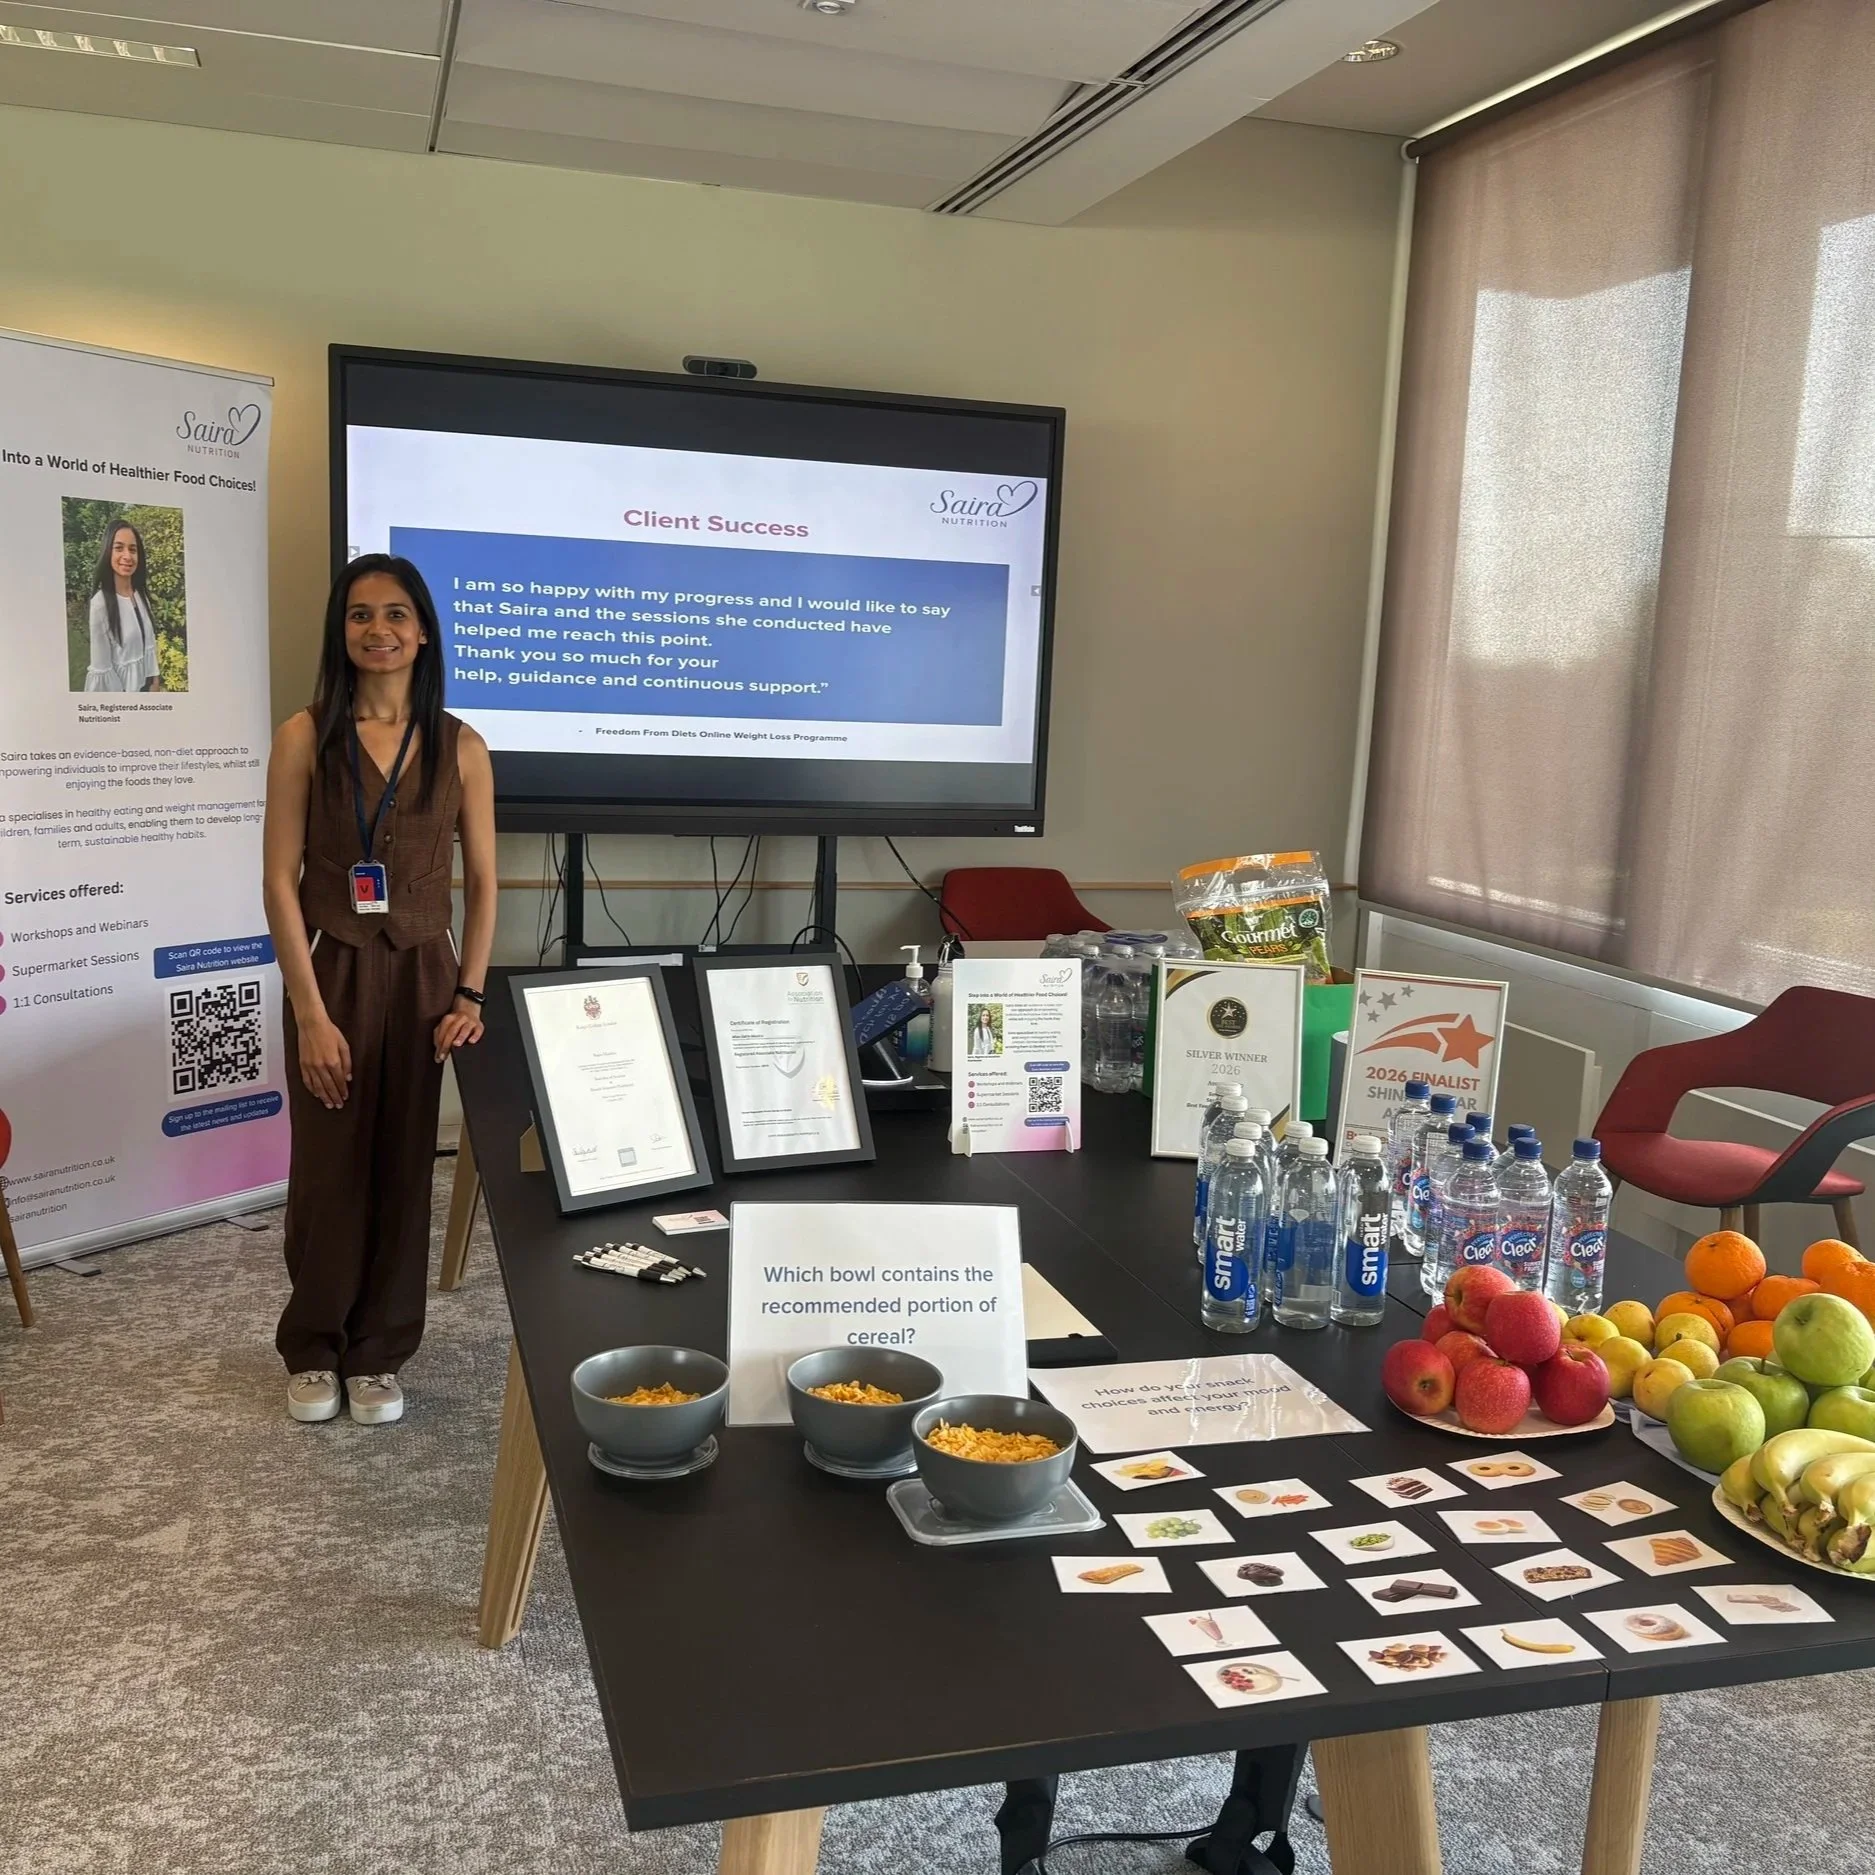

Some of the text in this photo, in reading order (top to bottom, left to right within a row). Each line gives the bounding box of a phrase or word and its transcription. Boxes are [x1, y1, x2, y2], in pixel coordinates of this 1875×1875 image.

[176, 409, 243, 446] Saira
[187, 444, 240, 459] NUTRITION
[2, 450, 256, 492] Into a World of Healthier Food Choices!
[930, 487, 1012, 518] Saira
[623, 509, 809, 538] Client Success
[941, 516, 1008, 529] NUTRITION
[454, 577, 951, 619] I am so happy with my progress and I would like to say
[453, 600, 892, 634] that Saira and the sessions she conducted have
[454, 623, 712, 647] helped me reach this point.
[454, 645, 719, 670] Thank you so much for your
[454, 667, 502, 684] help,
[508, 670, 597, 686] guidance
[602, 675, 637, 687] and
[643, 676, 744, 691] continuous
[78, 703, 173, 713] Saira, Registered Associate
[79, 715, 121, 723] Nutritionist
[595, 727, 848, 743] Freedom From Diets Online Weight Loss Programme
[1, 747, 249, 761] Saira takes an evidence-based, non-diet approach to
[54, 764, 106, 775] individuals
[108, 764, 117, 773] to
[119, 763, 157, 774] improve
[159, 762, 179, 771] their
[66, 775, 196, 791] enjoying the foods they love.
[8, 801, 256, 824] specialises in healthy eating and weight management
[34, 825, 72, 836] families
[74, 823, 93, 833] and
[128, 819, 168, 830] enabling
[170, 817, 194, 827] them
[195, 817, 205, 825] to
[207, 814, 242, 825] develop
[84, 834, 140, 847] sustainable
[140, 832, 174, 843] healthy
[4, 881, 124, 904] Services offered:
[11, 919, 149, 943] Workshops and Webinars
[168, 951, 188, 960] Scan
[189, 948, 201, 957] QR
[202, 946, 222, 956] code
[223, 945, 232, 953] to
[1249, 944, 1289, 955] PEARS
[12, 951, 140, 977] Supermarket Sessions
[176, 963, 196, 973] Saira
[197, 959, 229, 970] Nutrition
[13, 985, 114, 1009] 1:1 Consultations
[1185, 1050, 1268, 1063] SILVER WINNER
[1211, 1063, 1241, 1076] 2026
[1365, 1066, 1480, 1091] 2026 FINALIST
[1367, 1086, 1405, 1102] SHIN
[1235, 1218, 1247, 1252] water
[1381, 1212, 1389, 1245] water
[1214, 1215, 1236, 1291] smart
[1360, 1213, 1382, 1286] smart
[1463, 1237, 1495, 1260] Clear
[1501, 1237, 1537, 1257] Clear
[1570, 1236, 1604, 1258] Clear
[763, 1265, 994, 1283] Which bowl contains the
[761, 1296, 997, 1317] recommended portion of
[847, 1327, 916, 1345] cereal?
[1081, 1384, 1292, 1410] choices affect your mood
[1094, 1387, 1140, 1398] How
[1139, 1384, 1161, 1393] do
[1206, 1377, 1256, 1388] snack
[1148, 1400, 1251, 1416] and energy?
